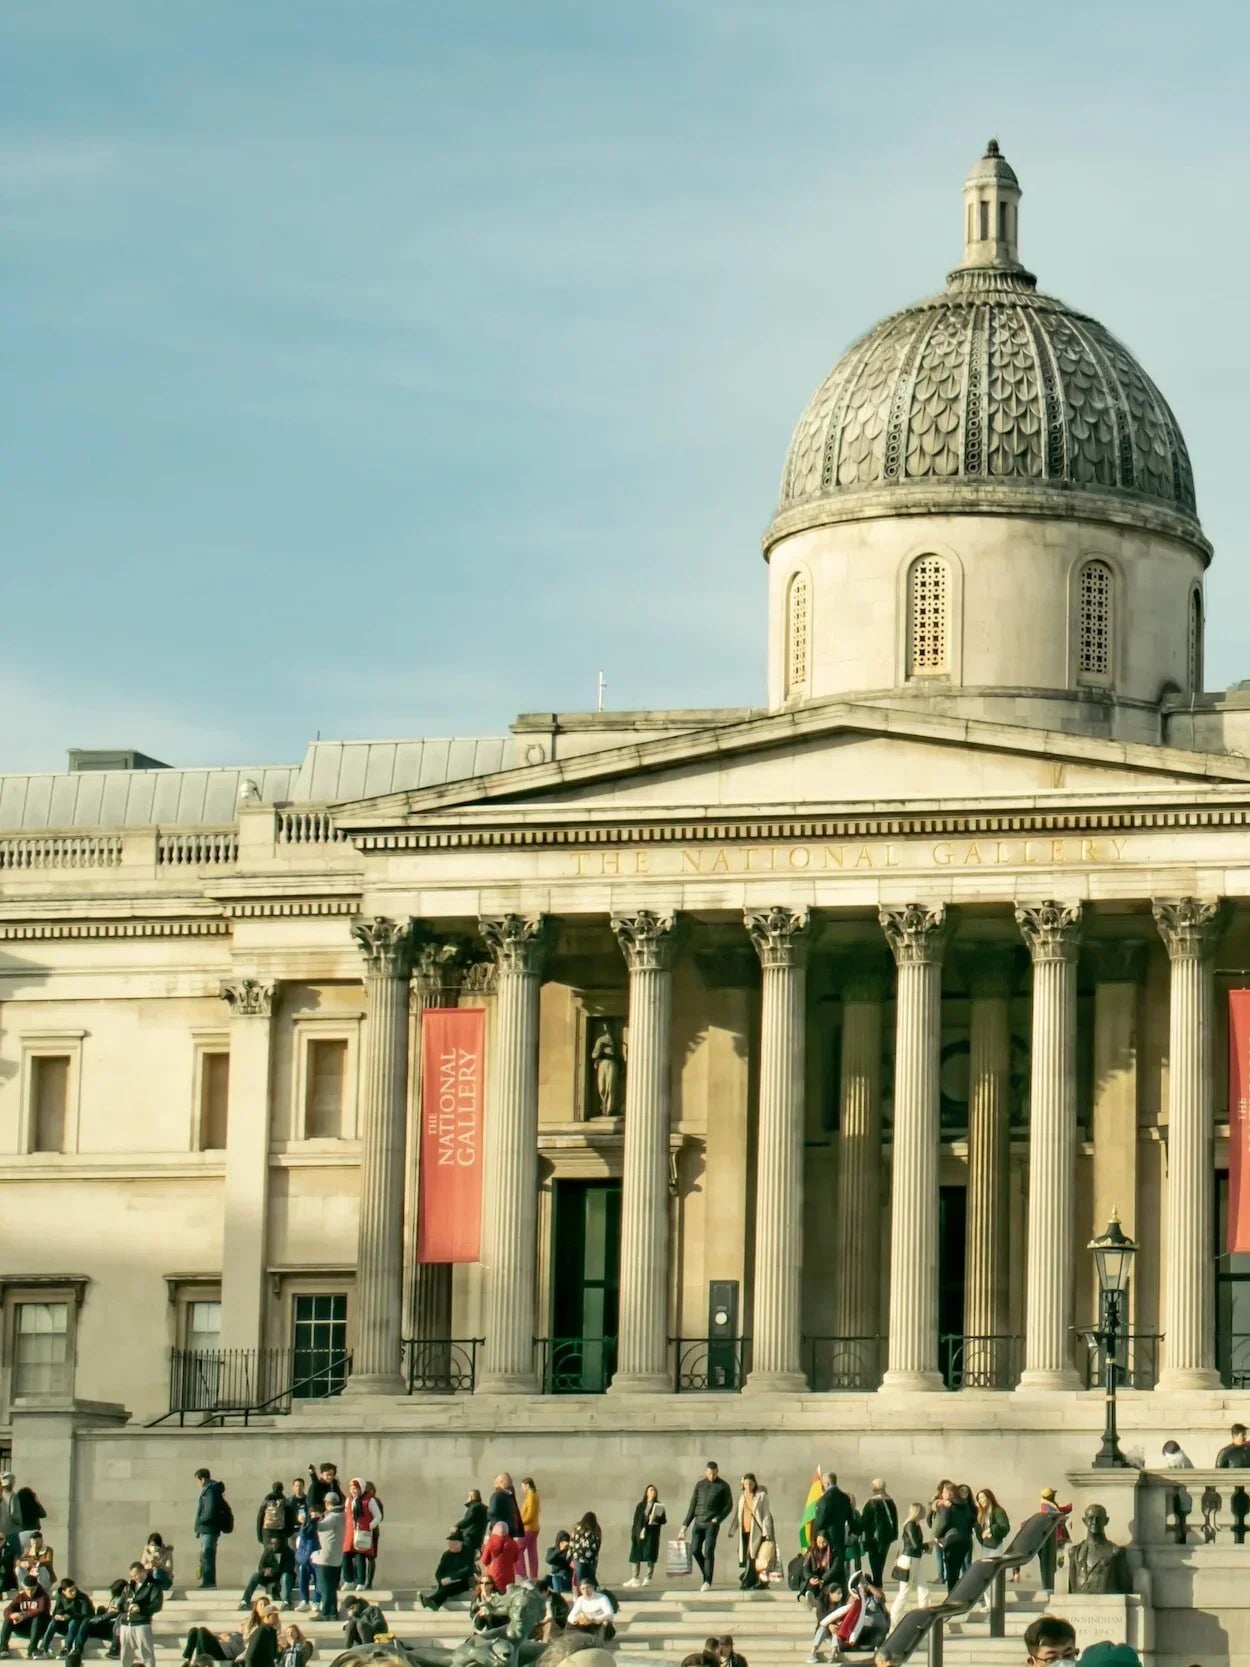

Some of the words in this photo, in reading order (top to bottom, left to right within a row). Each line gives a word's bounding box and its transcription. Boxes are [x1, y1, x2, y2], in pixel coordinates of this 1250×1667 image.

[569, 851, 650, 875] THE
[680, 845, 901, 873] NATIONAL
[932, 839, 1128, 866] GALLERY
[438, 1047, 457, 1166] NATIONAL
[457, 1048, 477, 1167] GALLERY
[1238, 1097, 1246, 1121] THE
[428, 1112, 438, 1136] THE
[1066, 1615, 1123, 1625] UNNINGHAM
